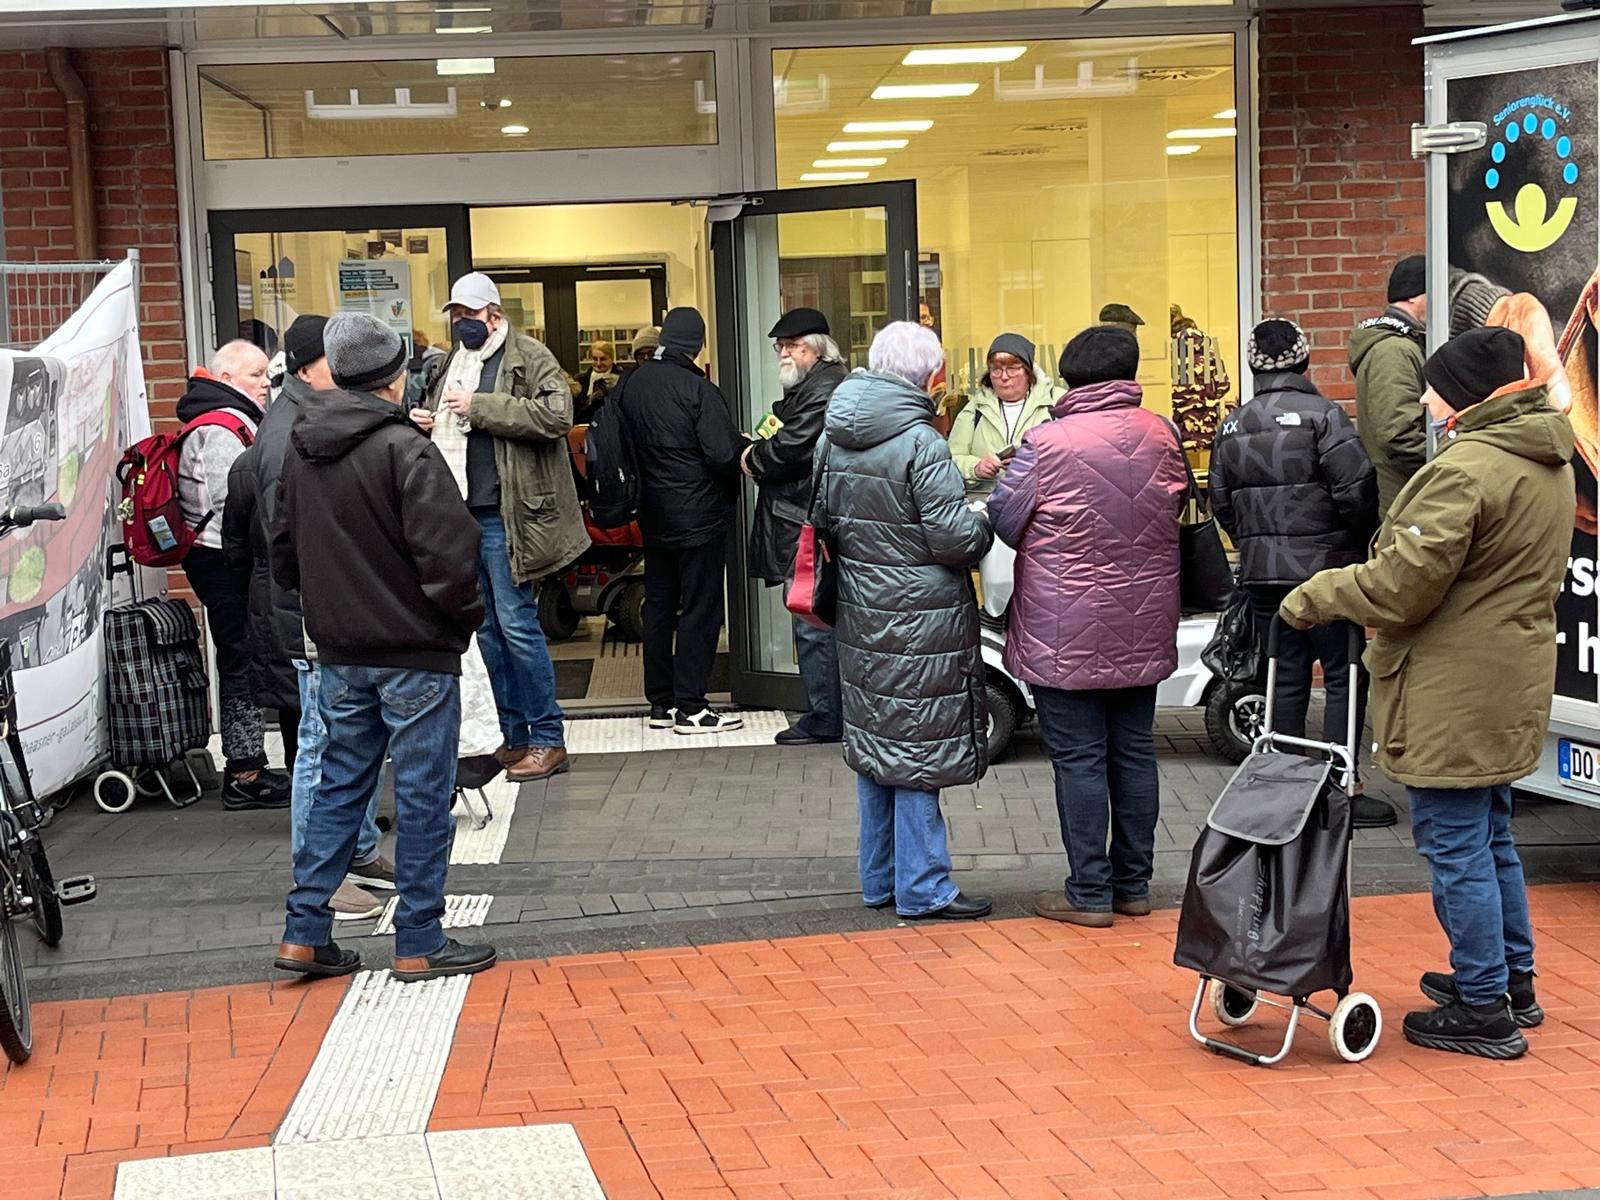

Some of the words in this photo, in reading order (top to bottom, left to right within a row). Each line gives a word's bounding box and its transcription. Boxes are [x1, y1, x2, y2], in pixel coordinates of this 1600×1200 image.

[1493, 94, 1553, 126] Seniorenglück
[1572, 748, 1593, 780] DO
[1247, 857, 1268, 940] Shopping
